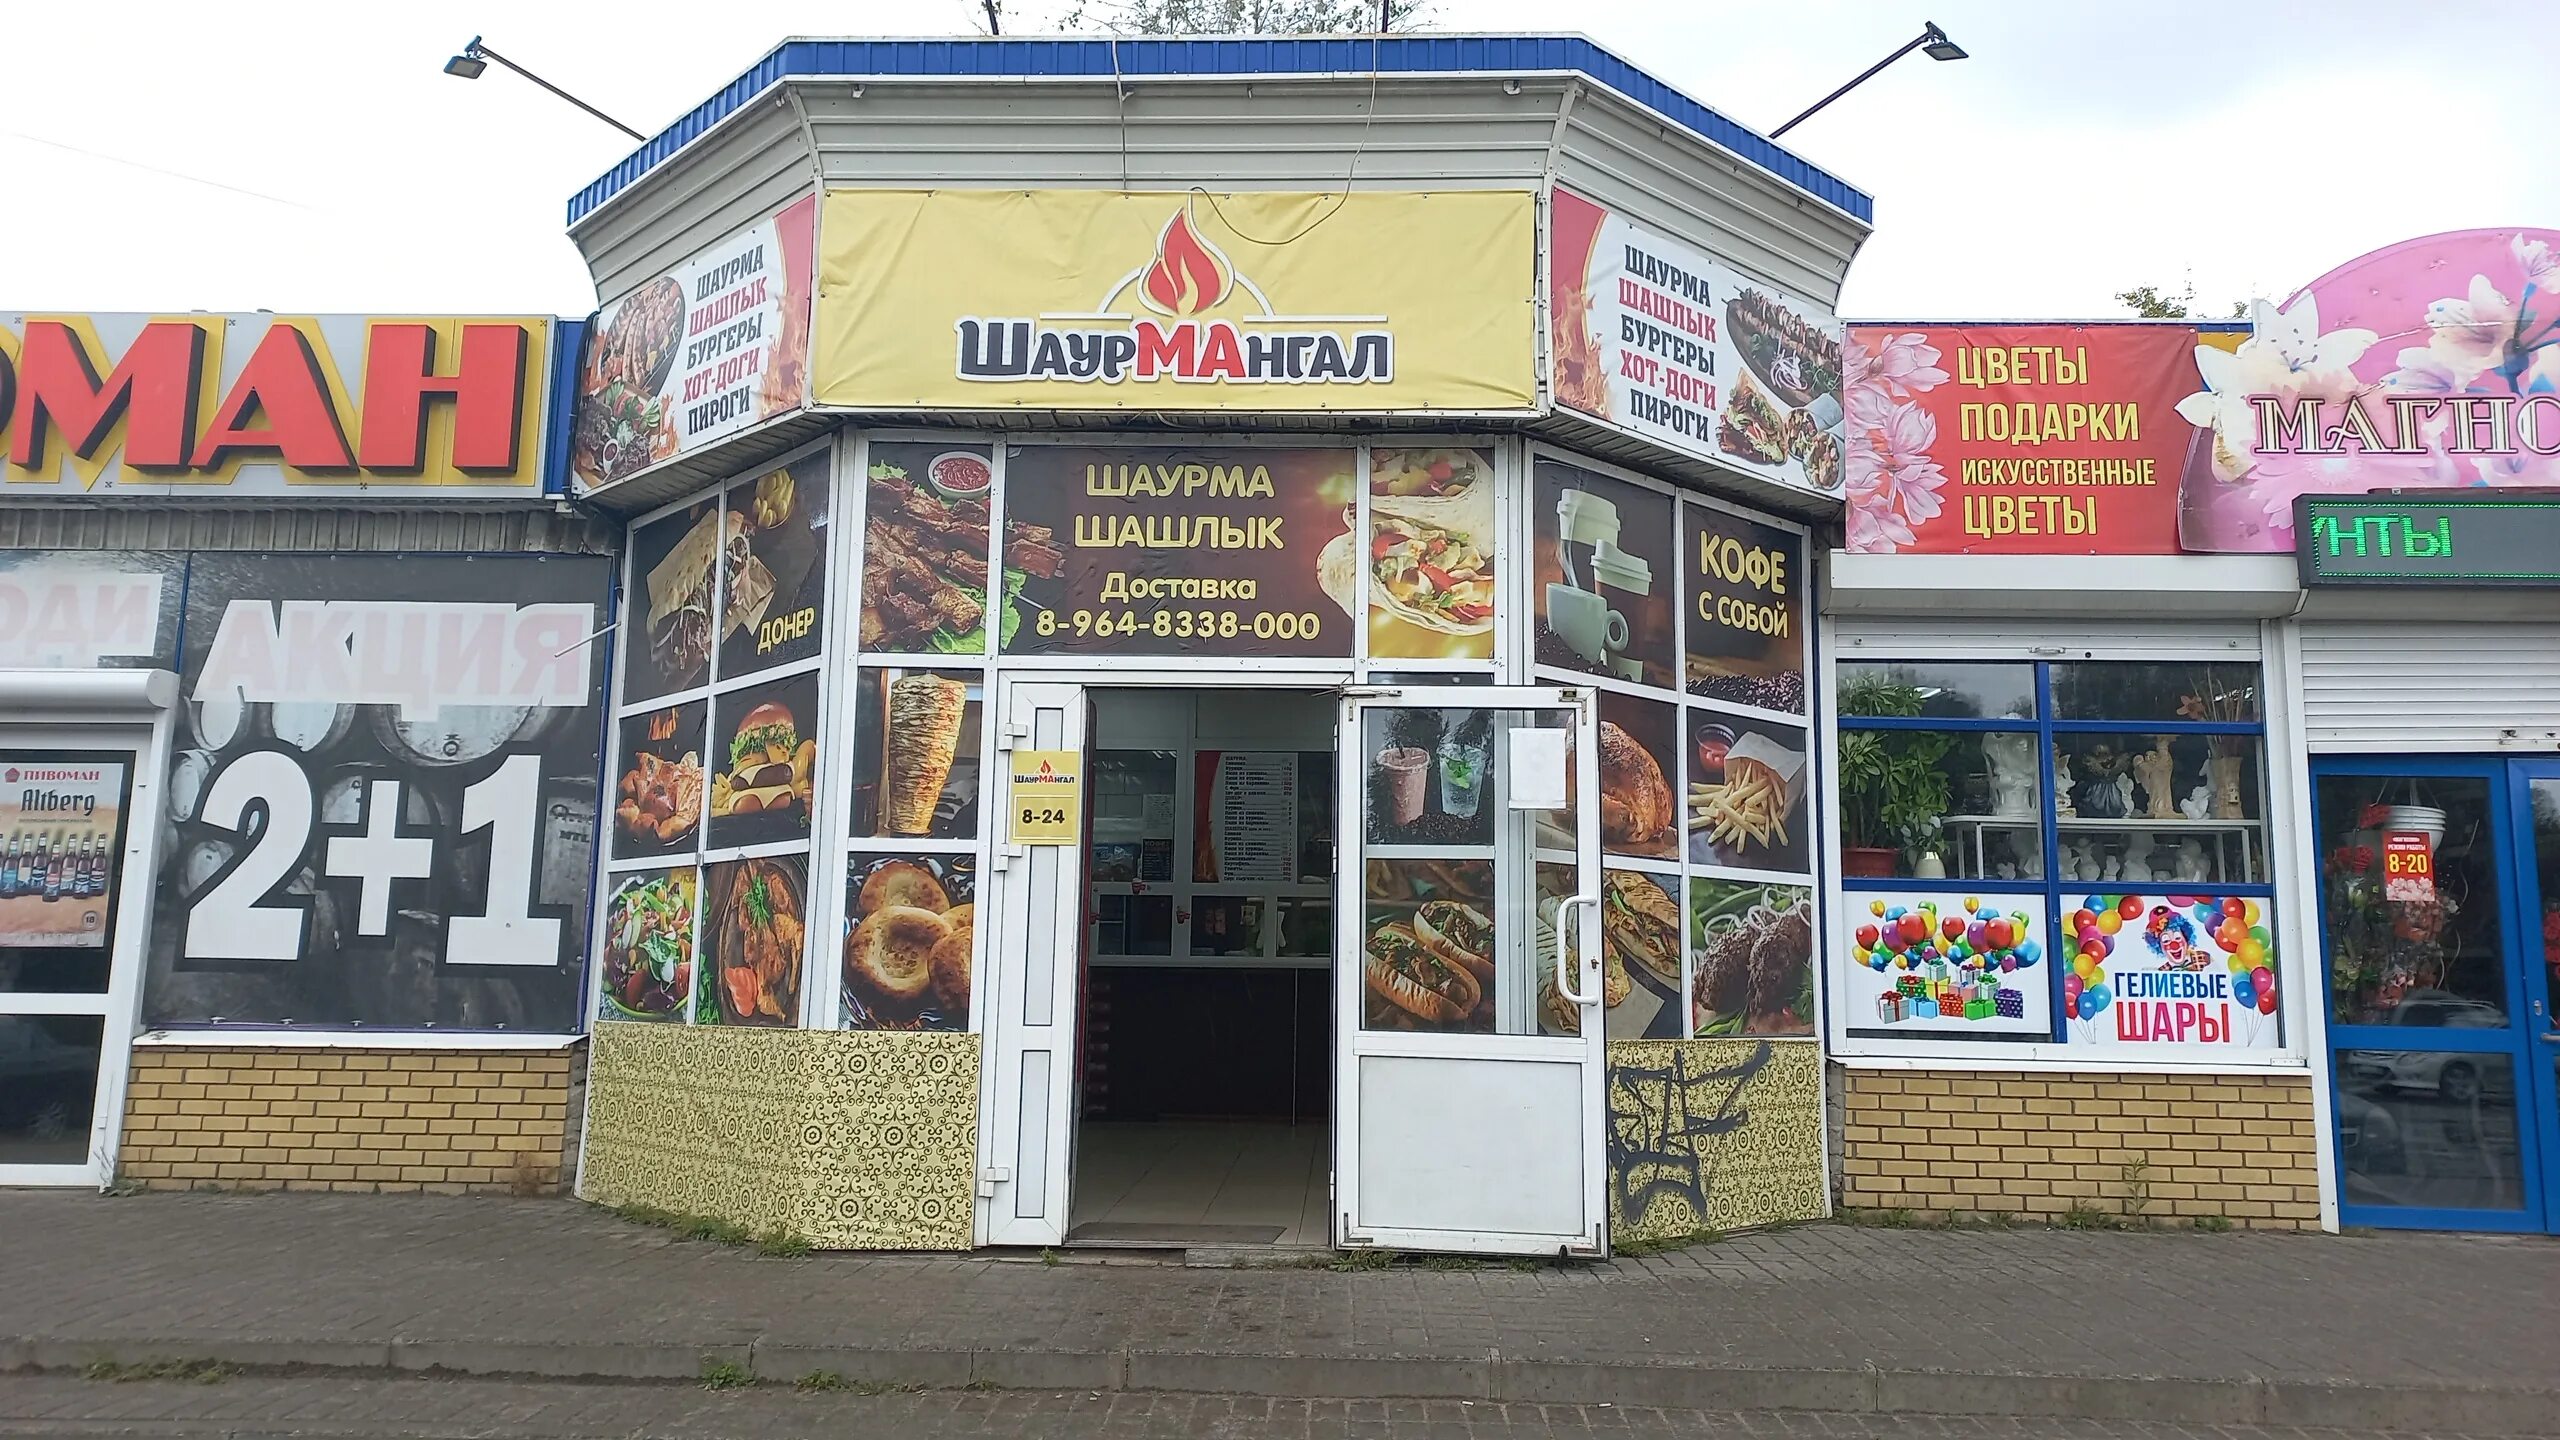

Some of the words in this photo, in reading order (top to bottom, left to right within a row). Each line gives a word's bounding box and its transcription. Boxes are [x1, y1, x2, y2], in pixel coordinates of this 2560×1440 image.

[695, 243, 764, 302] ШАУРМА
[1624, 244, 1712, 308] ШАУРМА
[688, 276, 768, 338] ШАШЛЫК
[1618, 277, 1717, 344] ШАШЛЫК
[686, 312, 763, 371] БУРГЕРЫ
[1620, 313, 1716, 377] БУРГЕРЫ
[682, 347, 761, 405] ХОТ-ДОГИ
[1620, 348, 1717, 412] ХОТ-ДОГИ
[1956, 346, 2089, 389] ЦВЕТЫ
[0, 321, 527, 472] МАН
[687, 385, 751, 436] ПИРОГИ
[1629, 388, 1710, 443] ПИРОГИ
[1959, 401, 2140, 447] ПОДАРКИ
[1084, 463, 1276, 499] ШАУРМА
[1960, 458, 2157, 487] ИСКУССТВЕННЫЕ
[1073, 515, 1286, 550] ШАШЛЫК
[1963, 495, 2098, 540] ЦВЕТЫ
[1699, 529, 1787, 596] КОФЕ
[1099, 572, 1258, 604] Доставка
[756, 606, 816, 656] ДОНЕР
[1035, 609, 1321, 641] 8-964-8338-000
[1716, 595, 1789, 640] СОБОЙ
[200, 603, 589, 719] АКЦИЯ
[23, 770, 101, 781] ПИВОМАН
[20, 788, 96, 816] Altberg
[1021, 808, 1066, 825] 8-24
[184, 750, 561, 966] 2+1
[2388, 853, 2428, 874] 8-20
[2114, 971, 2229, 1000] ГЕЛИЕВЫЕ
[2116, 1001, 2231, 1044] ШАРЫ
